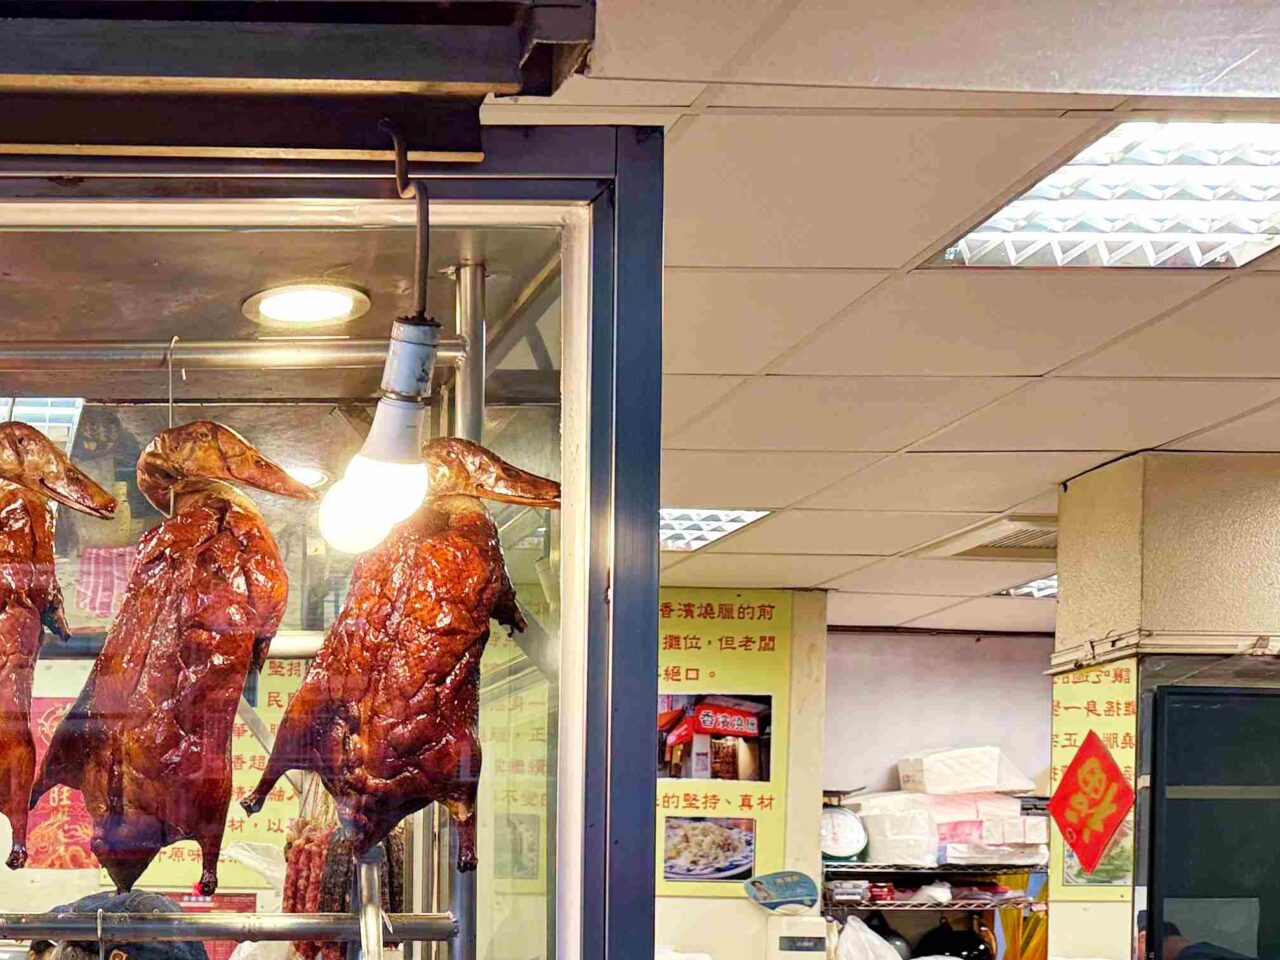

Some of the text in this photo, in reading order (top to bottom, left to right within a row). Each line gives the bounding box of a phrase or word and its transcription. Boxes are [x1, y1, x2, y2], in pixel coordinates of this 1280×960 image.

[658, 601, 776, 621] 香濱燒臘的前
[658, 665, 717, 683] 絕口。
[656, 791, 776, 812] 的堅持、真材
